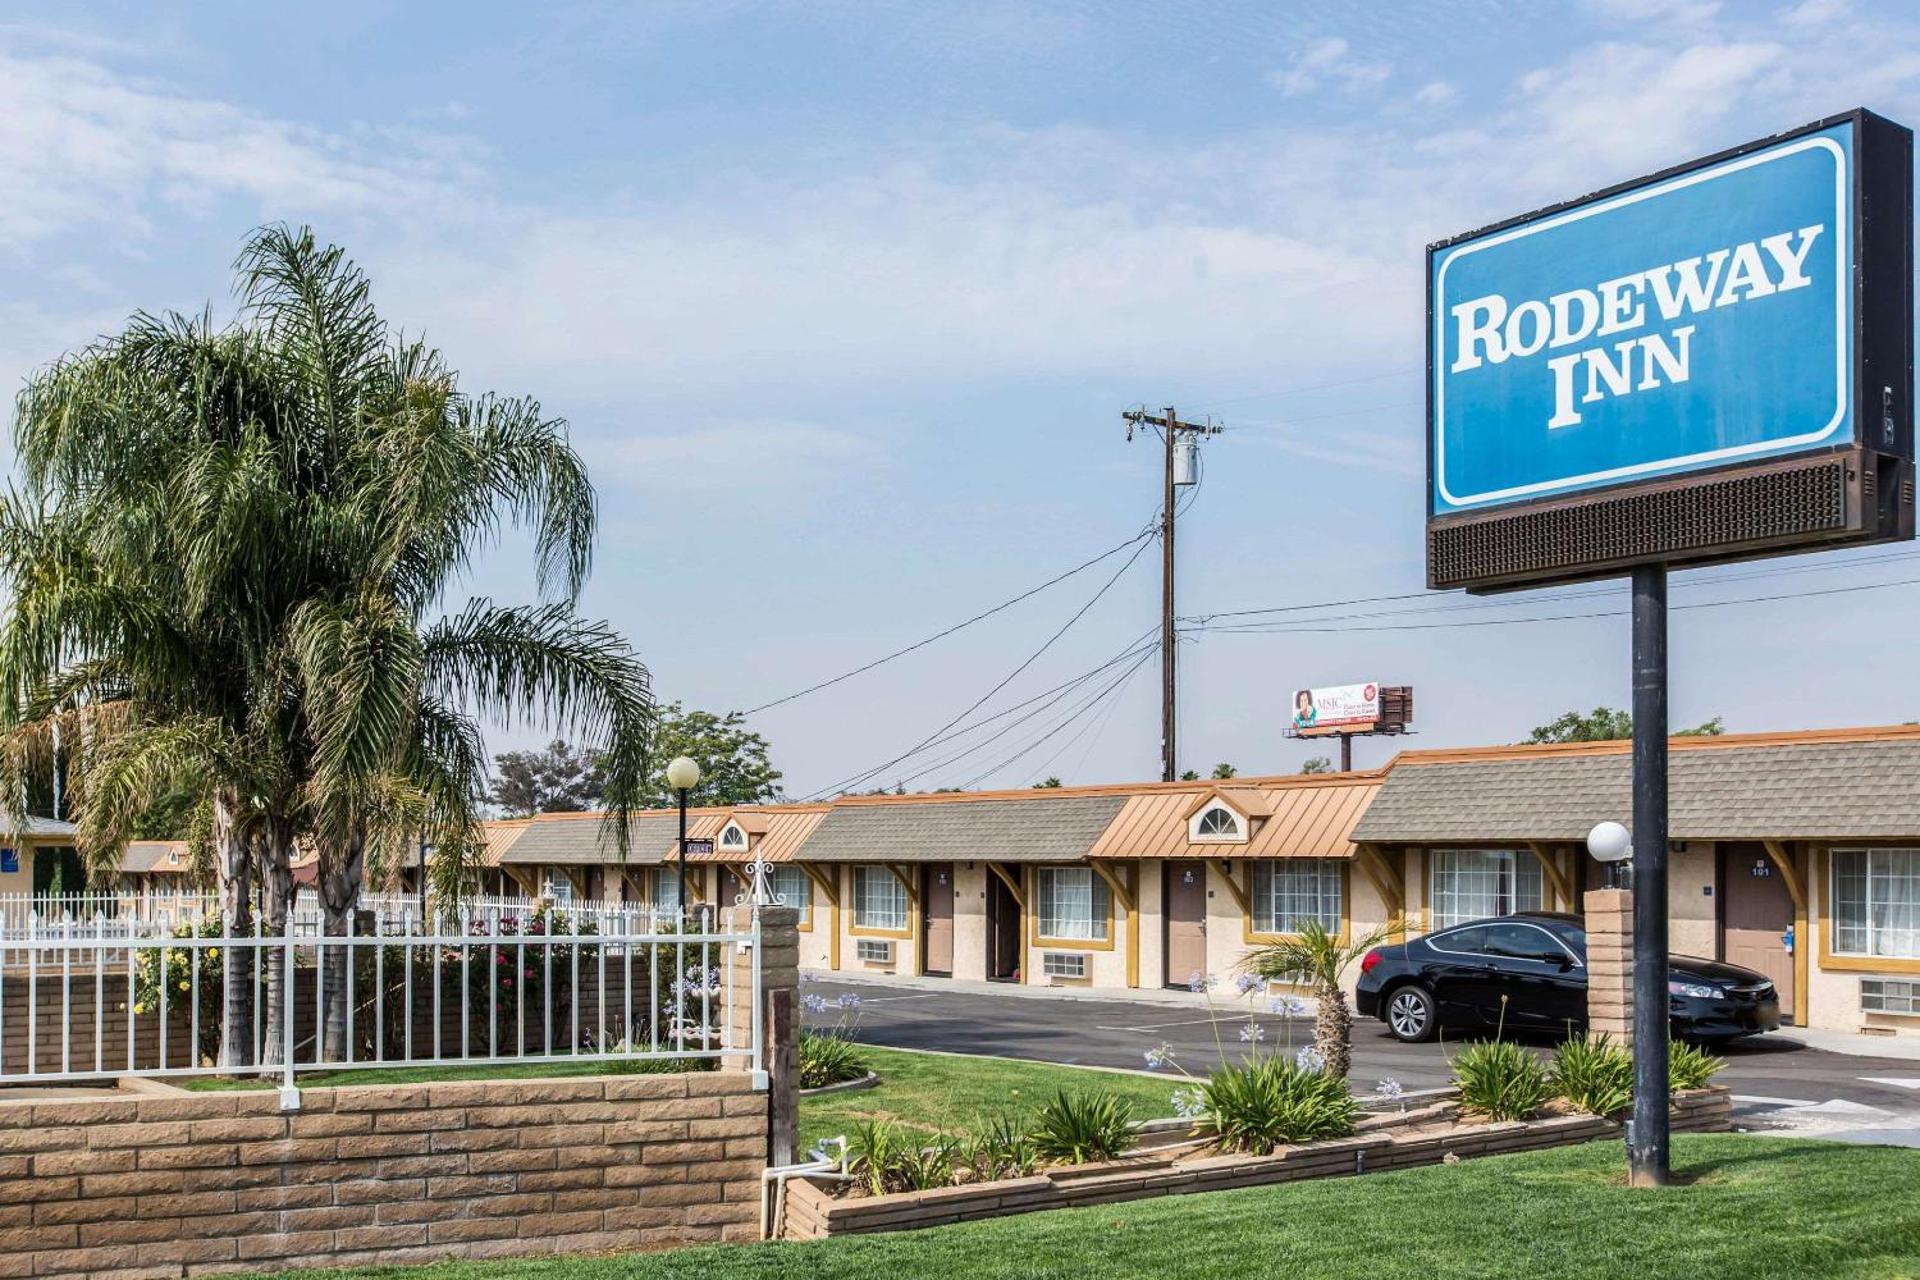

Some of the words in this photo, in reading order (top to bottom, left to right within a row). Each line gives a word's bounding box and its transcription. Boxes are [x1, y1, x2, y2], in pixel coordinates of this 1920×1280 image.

[1451, 224, 1824, 374] RODEWAY
[1548, 325, 1695, 430] INN
[1752, 867, 1769, 876] 101
